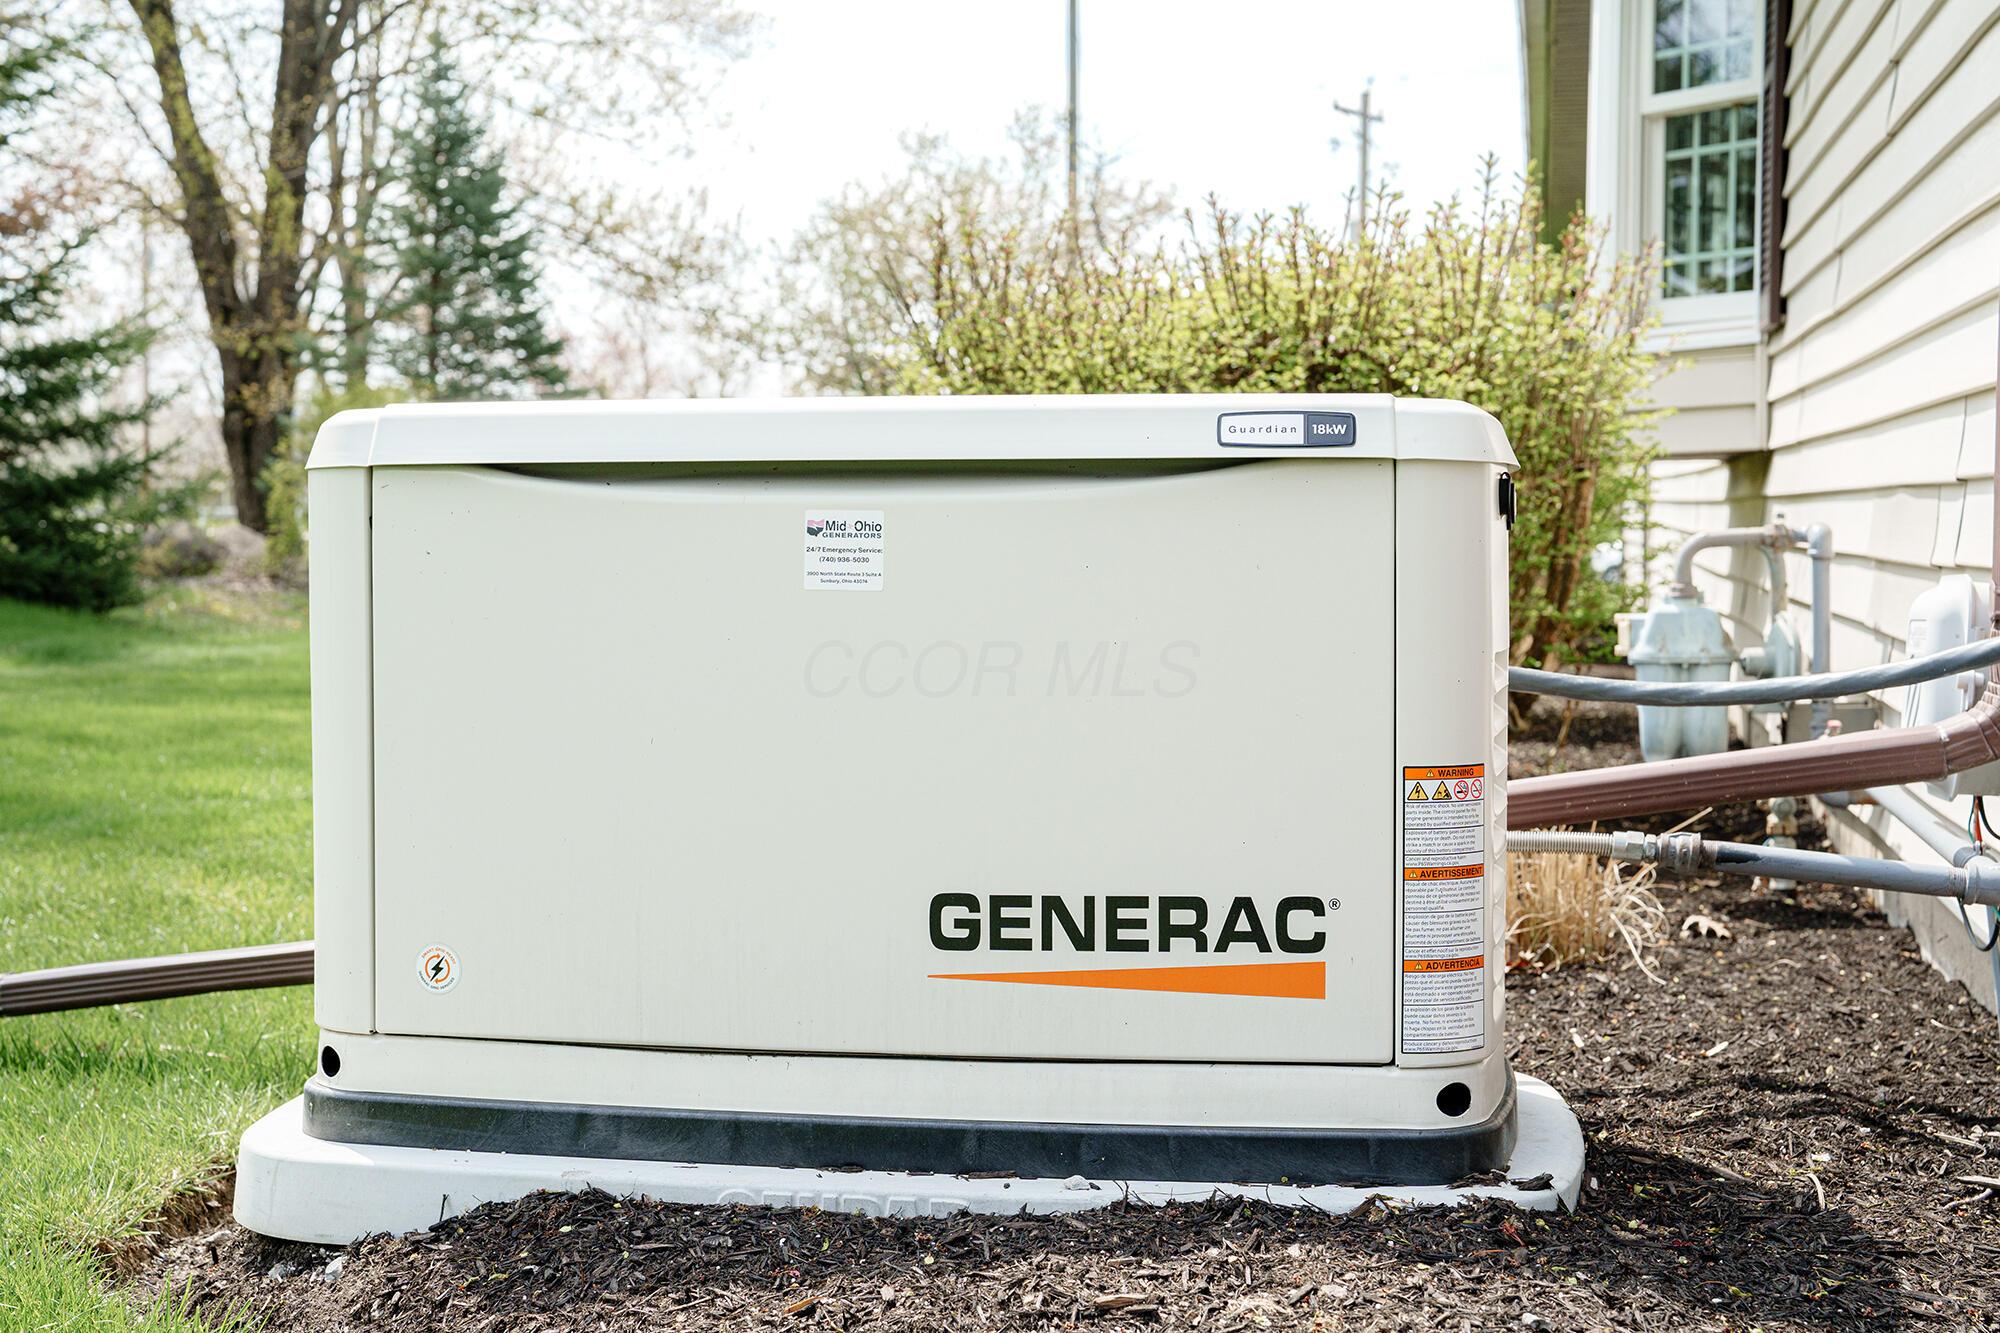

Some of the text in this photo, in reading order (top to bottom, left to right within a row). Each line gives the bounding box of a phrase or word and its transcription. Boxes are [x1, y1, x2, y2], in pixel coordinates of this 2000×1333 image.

[1228, 424, 1347, 435] Guardian 18kW
[825, 520, 882, 532] Mid Ohio
[1438, 768, 1474, 777] WARNING
[1420, 867, 1482, 878] AVERTISSEMENT
[929, 893, 1327, 954] GENERAC
[1426, 959, 1480, 970] ADVERTENCIA
